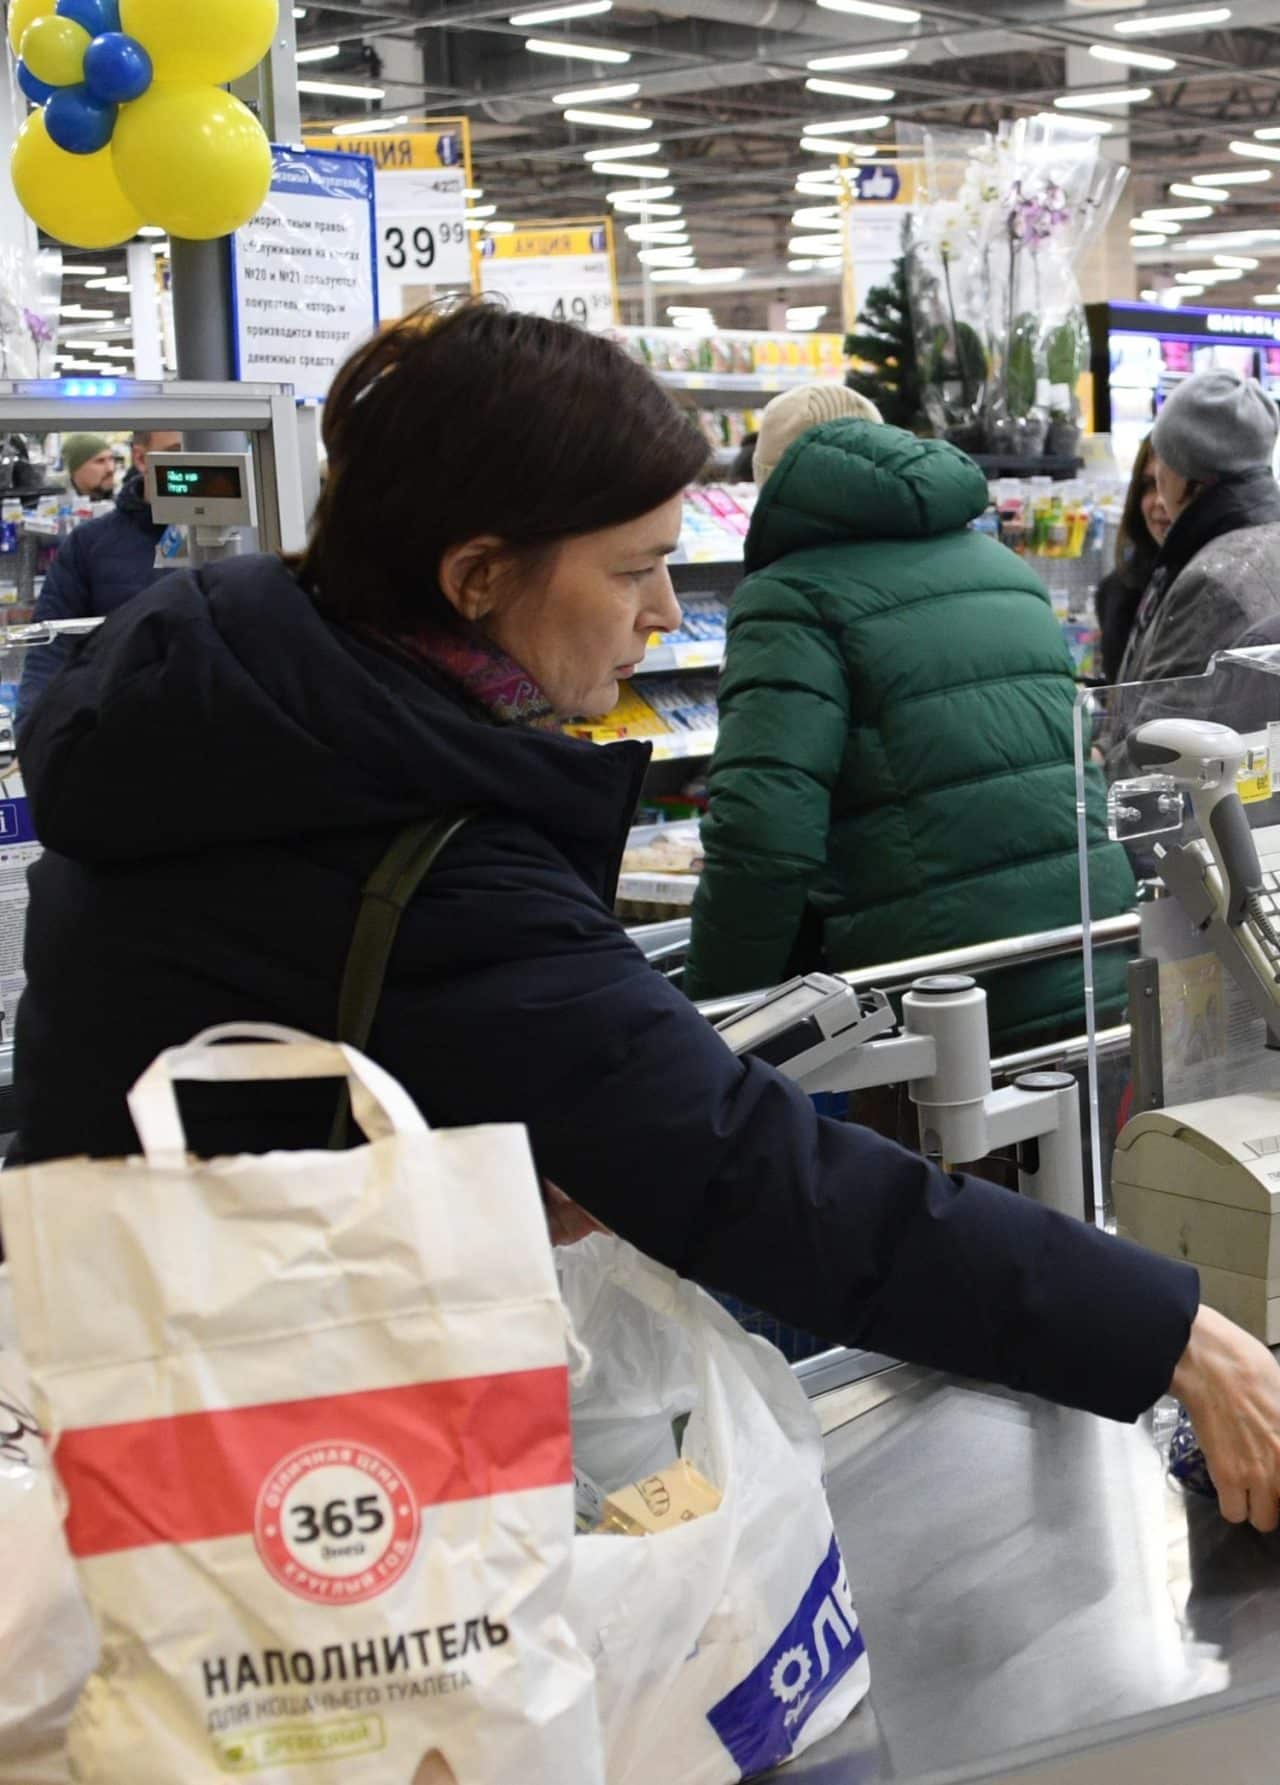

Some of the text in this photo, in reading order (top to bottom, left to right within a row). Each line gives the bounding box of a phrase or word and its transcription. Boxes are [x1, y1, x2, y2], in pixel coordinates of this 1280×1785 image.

[248, 216, 312, 230] риориттным
[384, 221, 465, 269] 39 99
[244, 267, 267, 280] №20
[279, 271, 300, 283] №21
[264, 1448, 400, 1509] ОТЛИЧНАЯ ЦЕНА
[290, 1495, 385, 1544] 365
[202, 1614, 511, 1699] НАПОЛНИТЕЛЬ
[207, 1704, 250, 1733] ДЛЯ
[386, 1670, 473, 1703] ТУАЛЕТА
